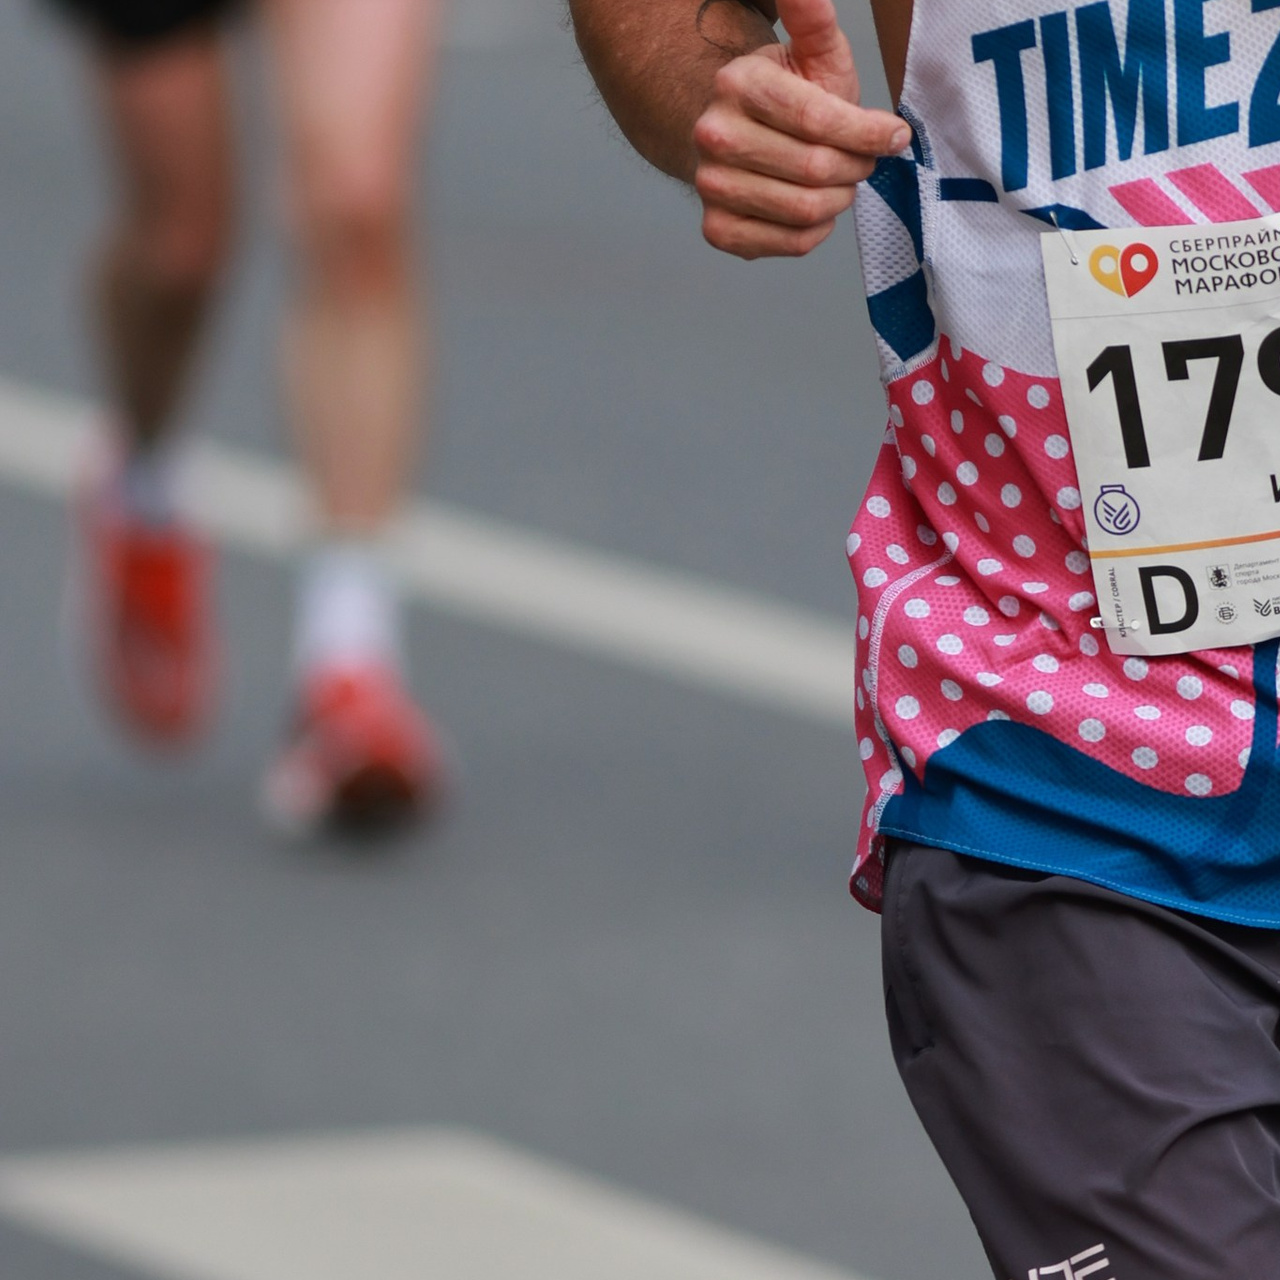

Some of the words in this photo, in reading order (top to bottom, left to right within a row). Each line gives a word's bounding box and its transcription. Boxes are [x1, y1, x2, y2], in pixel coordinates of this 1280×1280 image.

[1108, 566, 1120, 598] CORRAL
[1138, 564, 1199, 636] D
[1114, 602, 1127, 638] КЛАСТЕР
